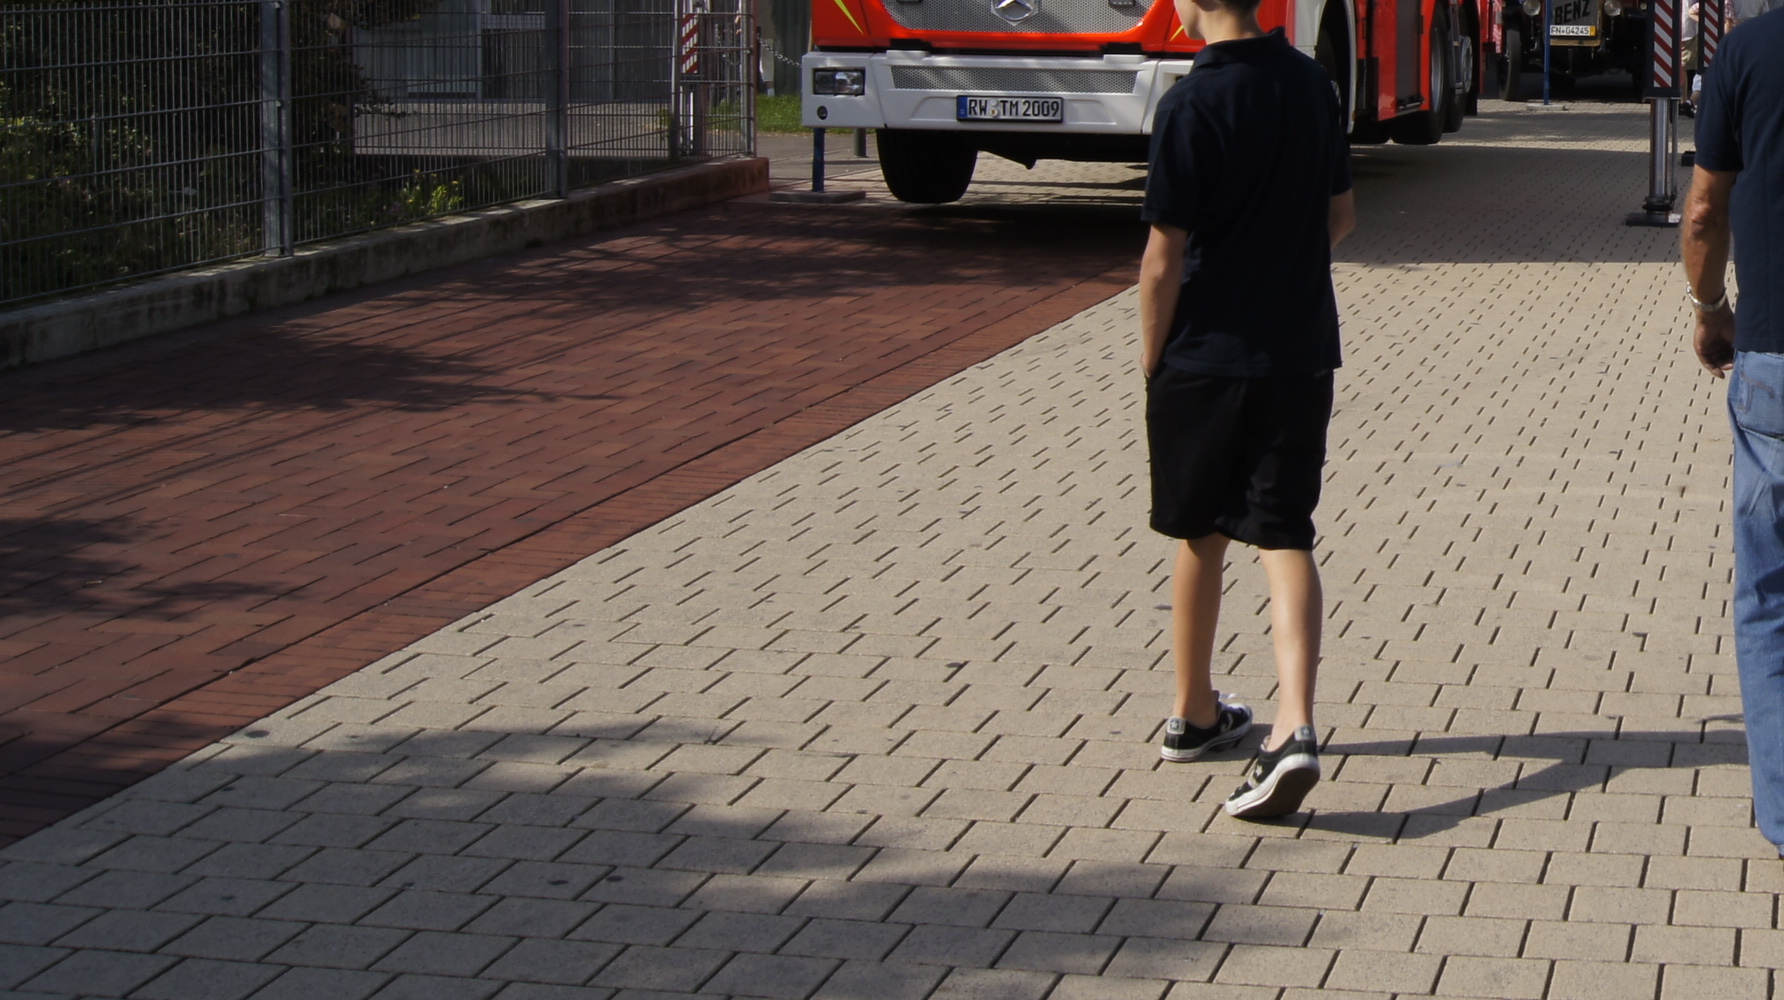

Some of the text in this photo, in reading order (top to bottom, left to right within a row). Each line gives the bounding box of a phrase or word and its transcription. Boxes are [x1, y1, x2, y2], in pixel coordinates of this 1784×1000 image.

[1551, 26, 1561, 34] FN
[968, 99, 1060, 117] RW TM 2009
